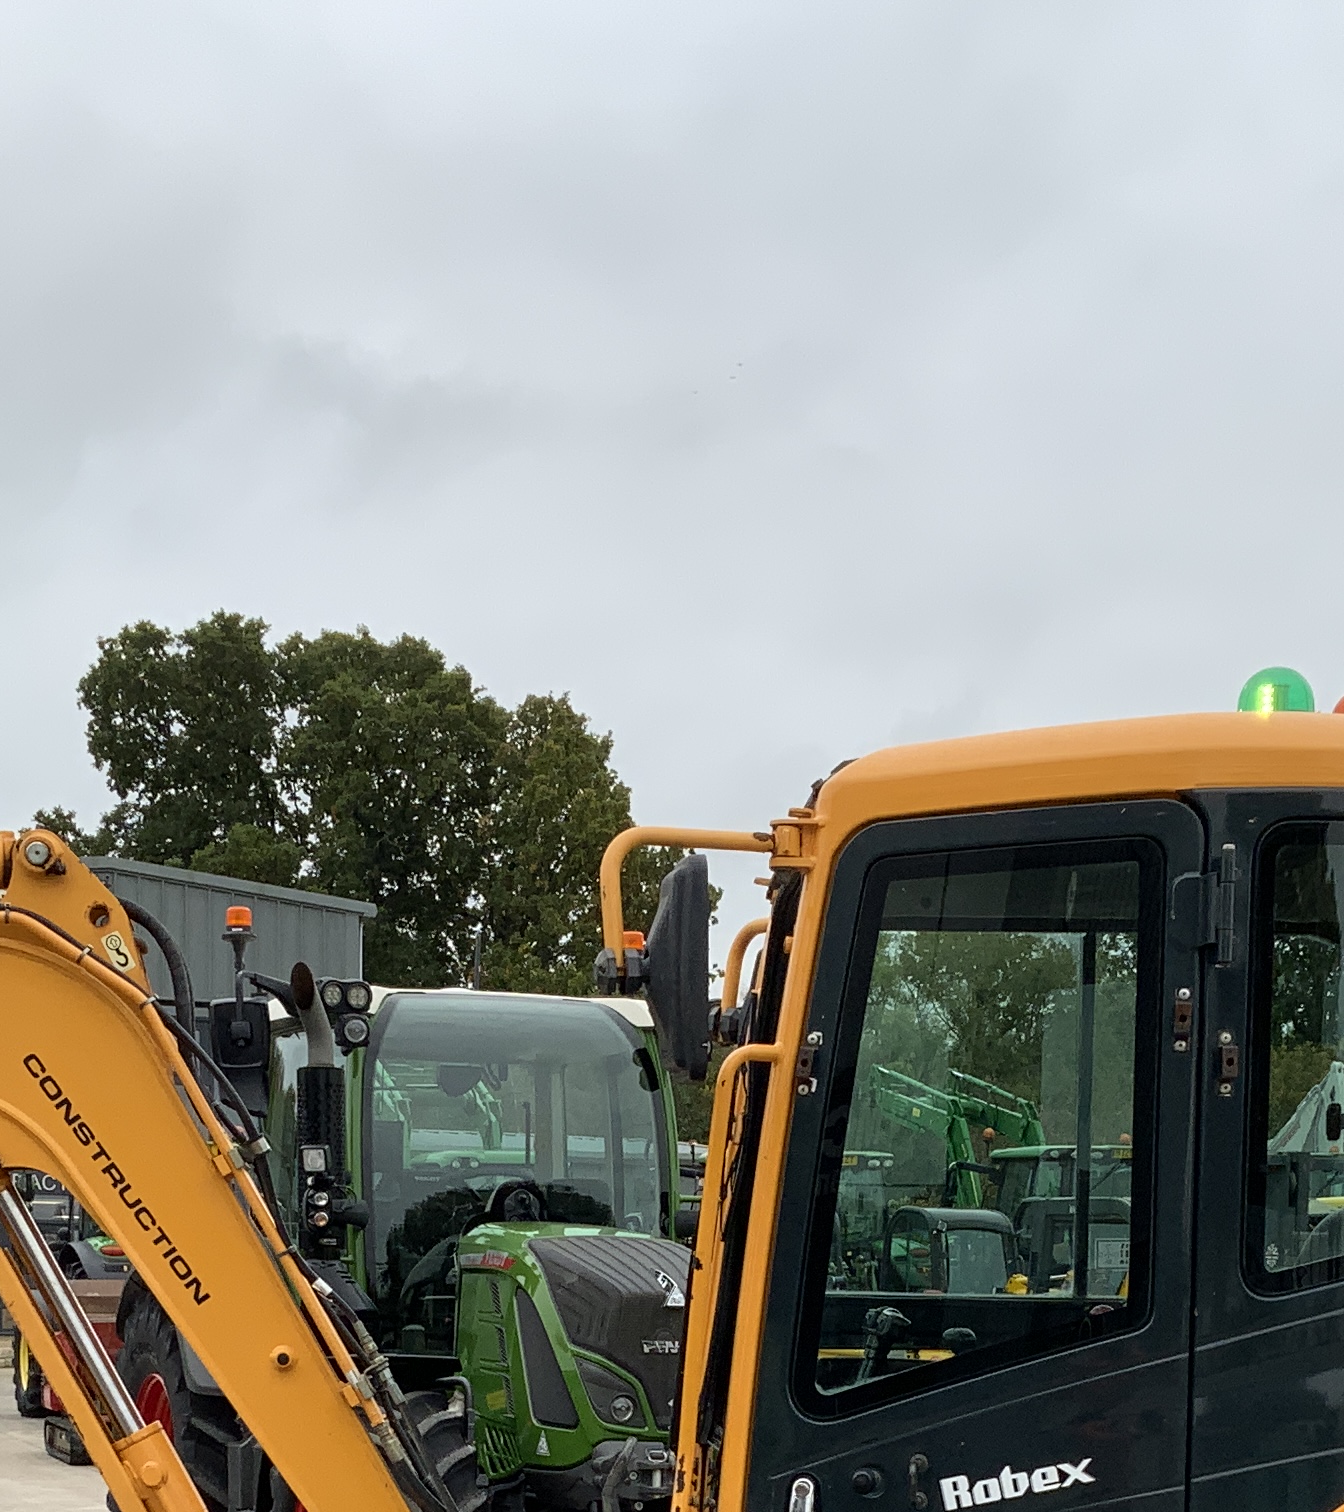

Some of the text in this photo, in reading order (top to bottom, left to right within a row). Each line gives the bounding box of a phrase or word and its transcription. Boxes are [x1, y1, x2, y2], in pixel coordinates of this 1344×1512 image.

[22, 1053, 211, 1306] CONSTRUCTION
[641, 1340, 681, 1354] FEN
[939, 1458, 1096, 1512] Robex
